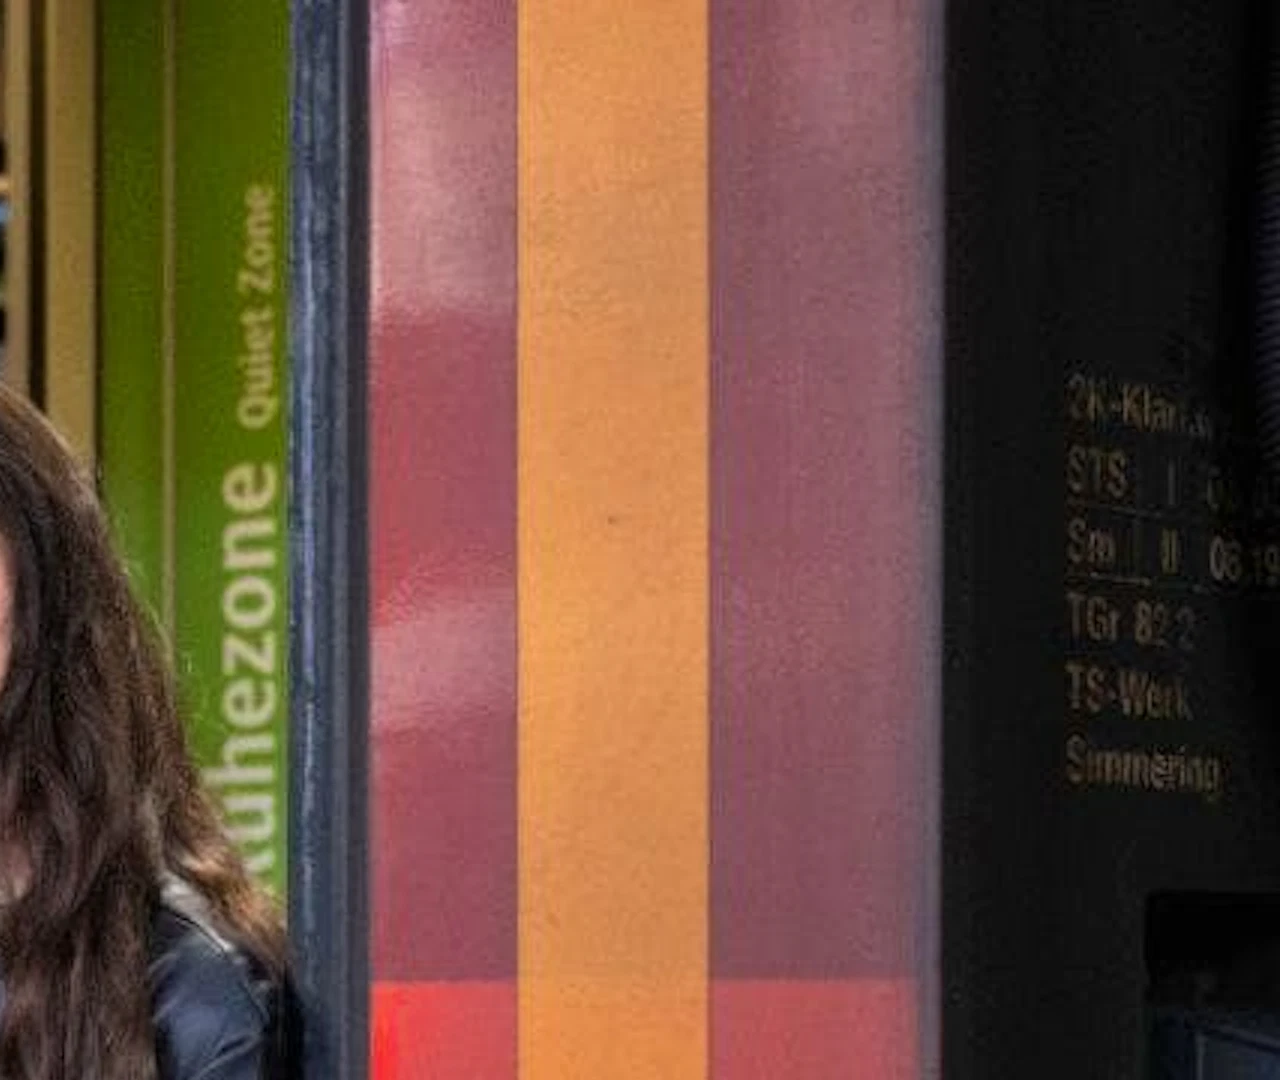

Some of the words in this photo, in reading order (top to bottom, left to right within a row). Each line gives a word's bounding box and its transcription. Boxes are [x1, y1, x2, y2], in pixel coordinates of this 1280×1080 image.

[238, 185, 275, 293] Zone
[237, 306, 277, 429] Quiet
[1068, 444, 1128, 498] STS
[1065, 661, 1194, 721] TS-Werk
[1066, 734, 1221, 803] Simmering
